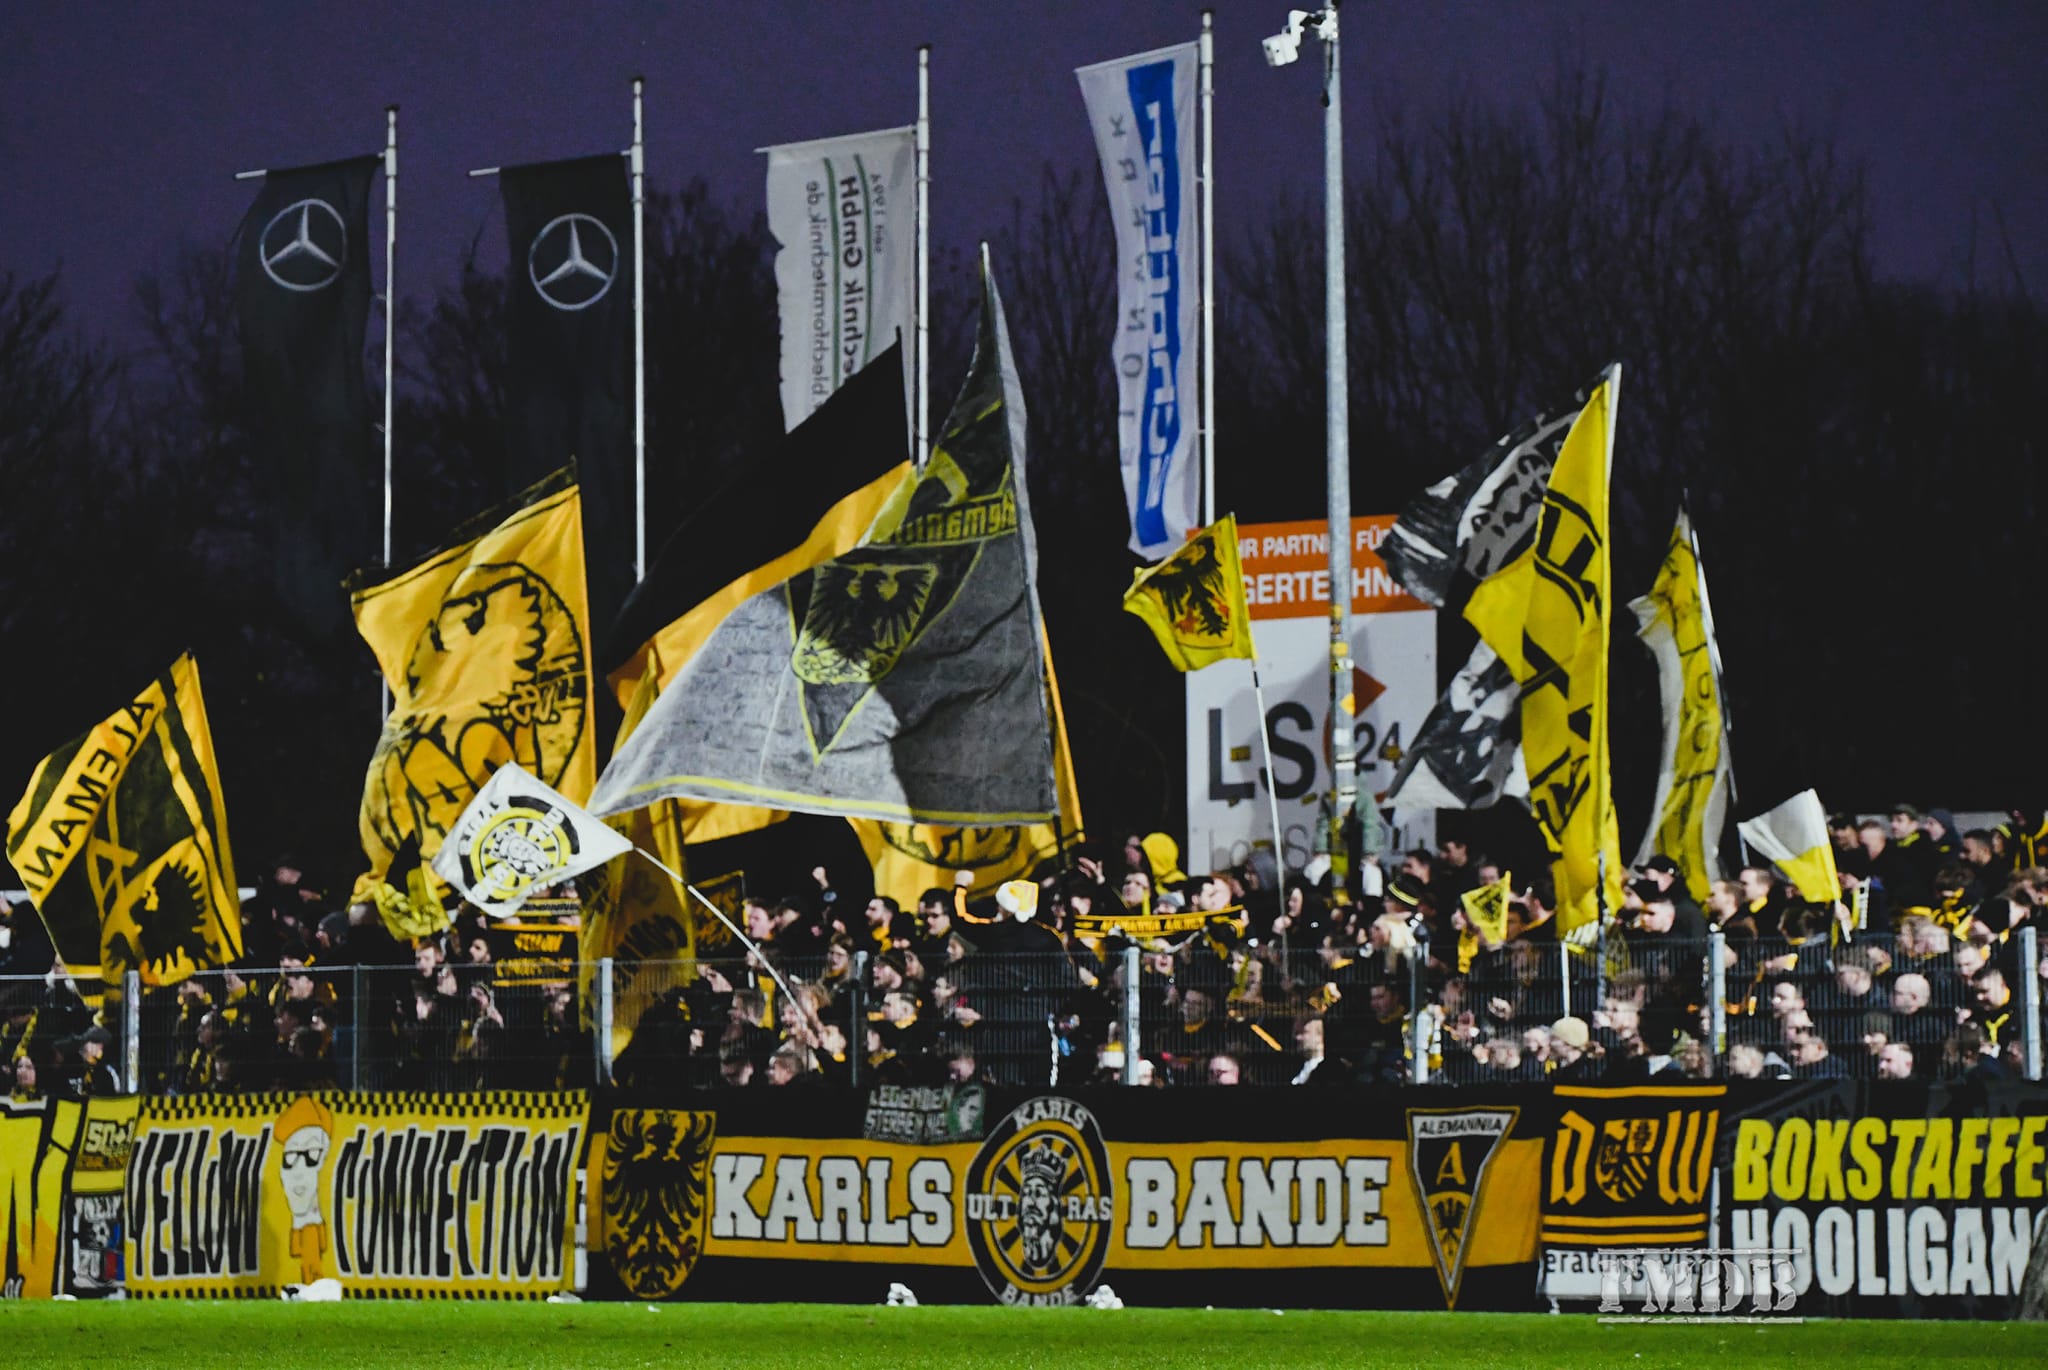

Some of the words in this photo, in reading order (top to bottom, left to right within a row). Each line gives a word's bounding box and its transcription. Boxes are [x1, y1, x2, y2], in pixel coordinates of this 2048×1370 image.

[1263, 532, 1330, 558] PARTN
[1013, 1100, 1088, 1131] KARLS
[1419, 1117, 1502, 1135] ALEMANNIA
[1732, 1115, 2048, 1201] BOXSTAFFE
[128, 1123, 272, 1280] YELLOW
[333, 1123, 581, 1280] CONNECTION
[710, 1153, 953, 1247] KARLS
[1125, 1156, 1390, 1248] BANDE
[1001, 1282, 1076, 1307] BANDE
[1732, 1206, 2048, 1296] HOOLIGAN
